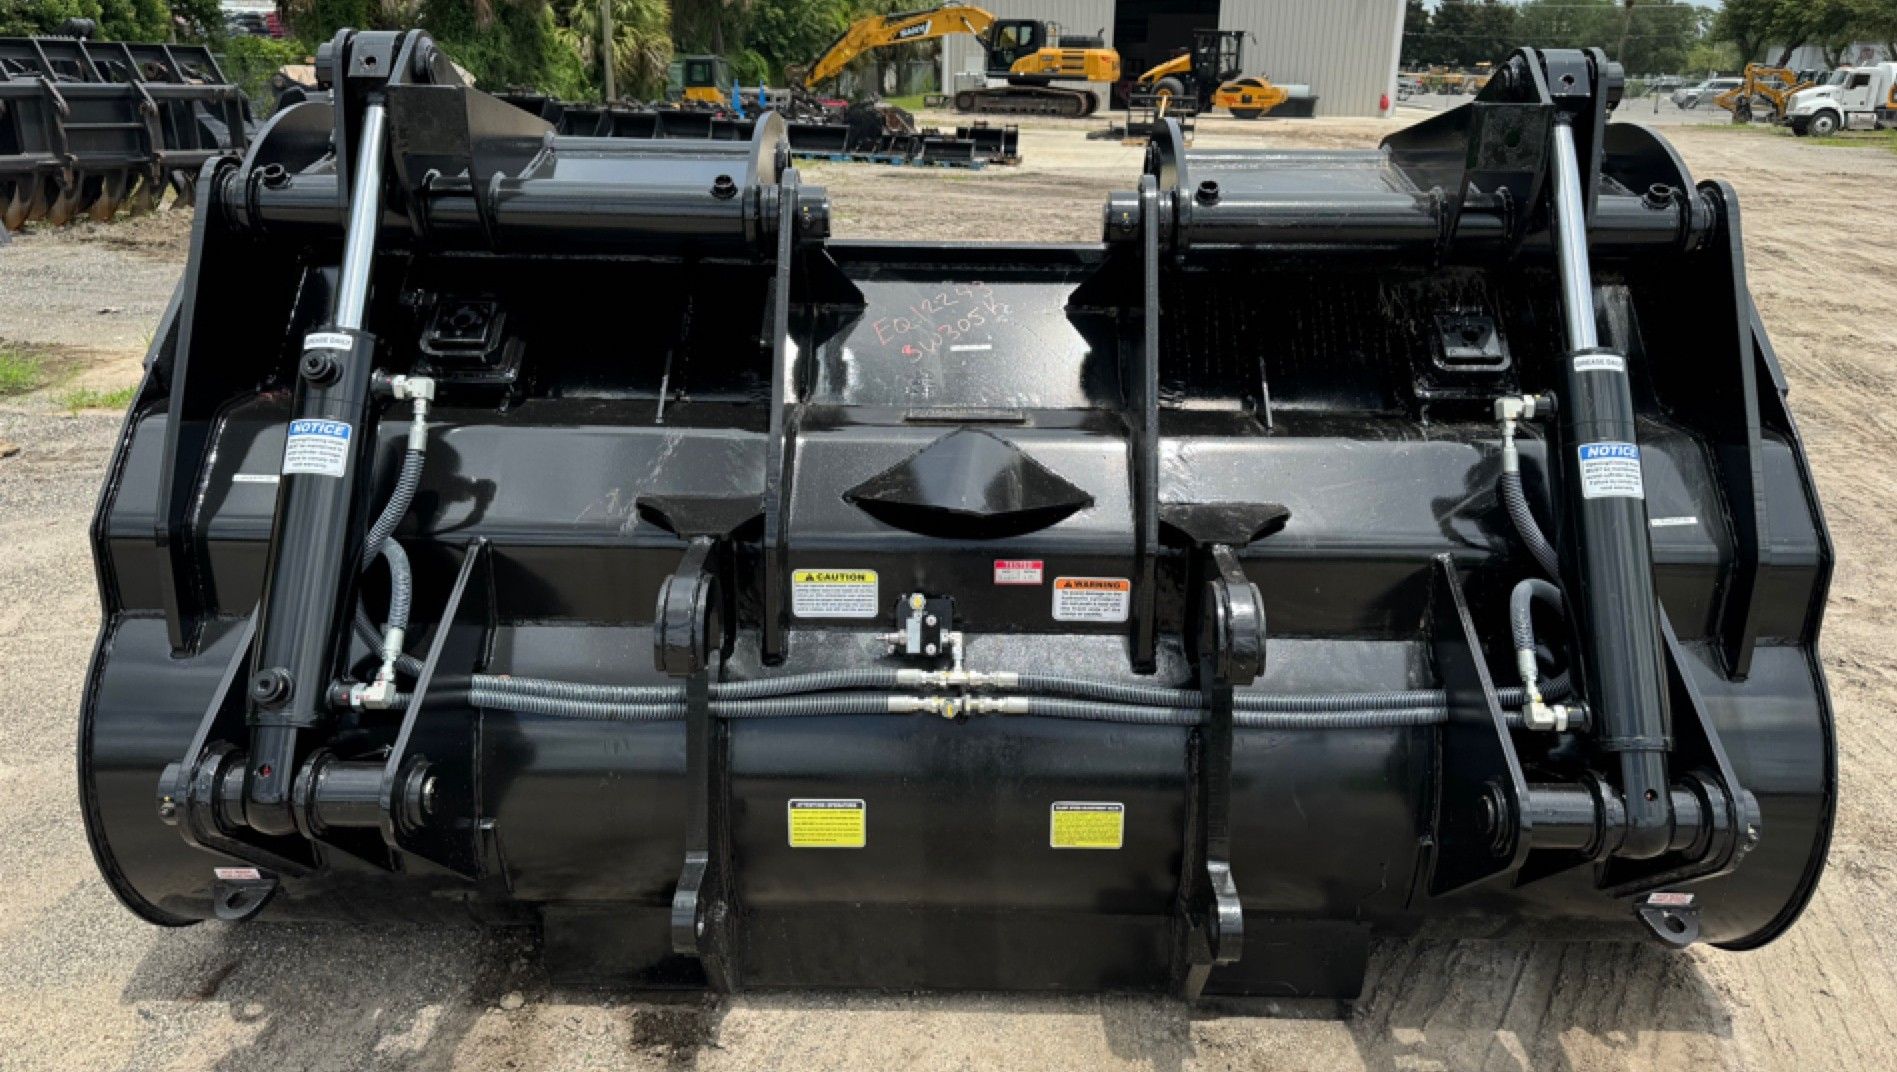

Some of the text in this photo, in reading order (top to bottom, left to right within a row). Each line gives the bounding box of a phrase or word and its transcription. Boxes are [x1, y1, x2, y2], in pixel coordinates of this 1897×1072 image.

[294, 422, 345, 436] NOTICE
[816, 573, 865, 581] CAUTION
[1073, 581, 1121, 589] WARNING
